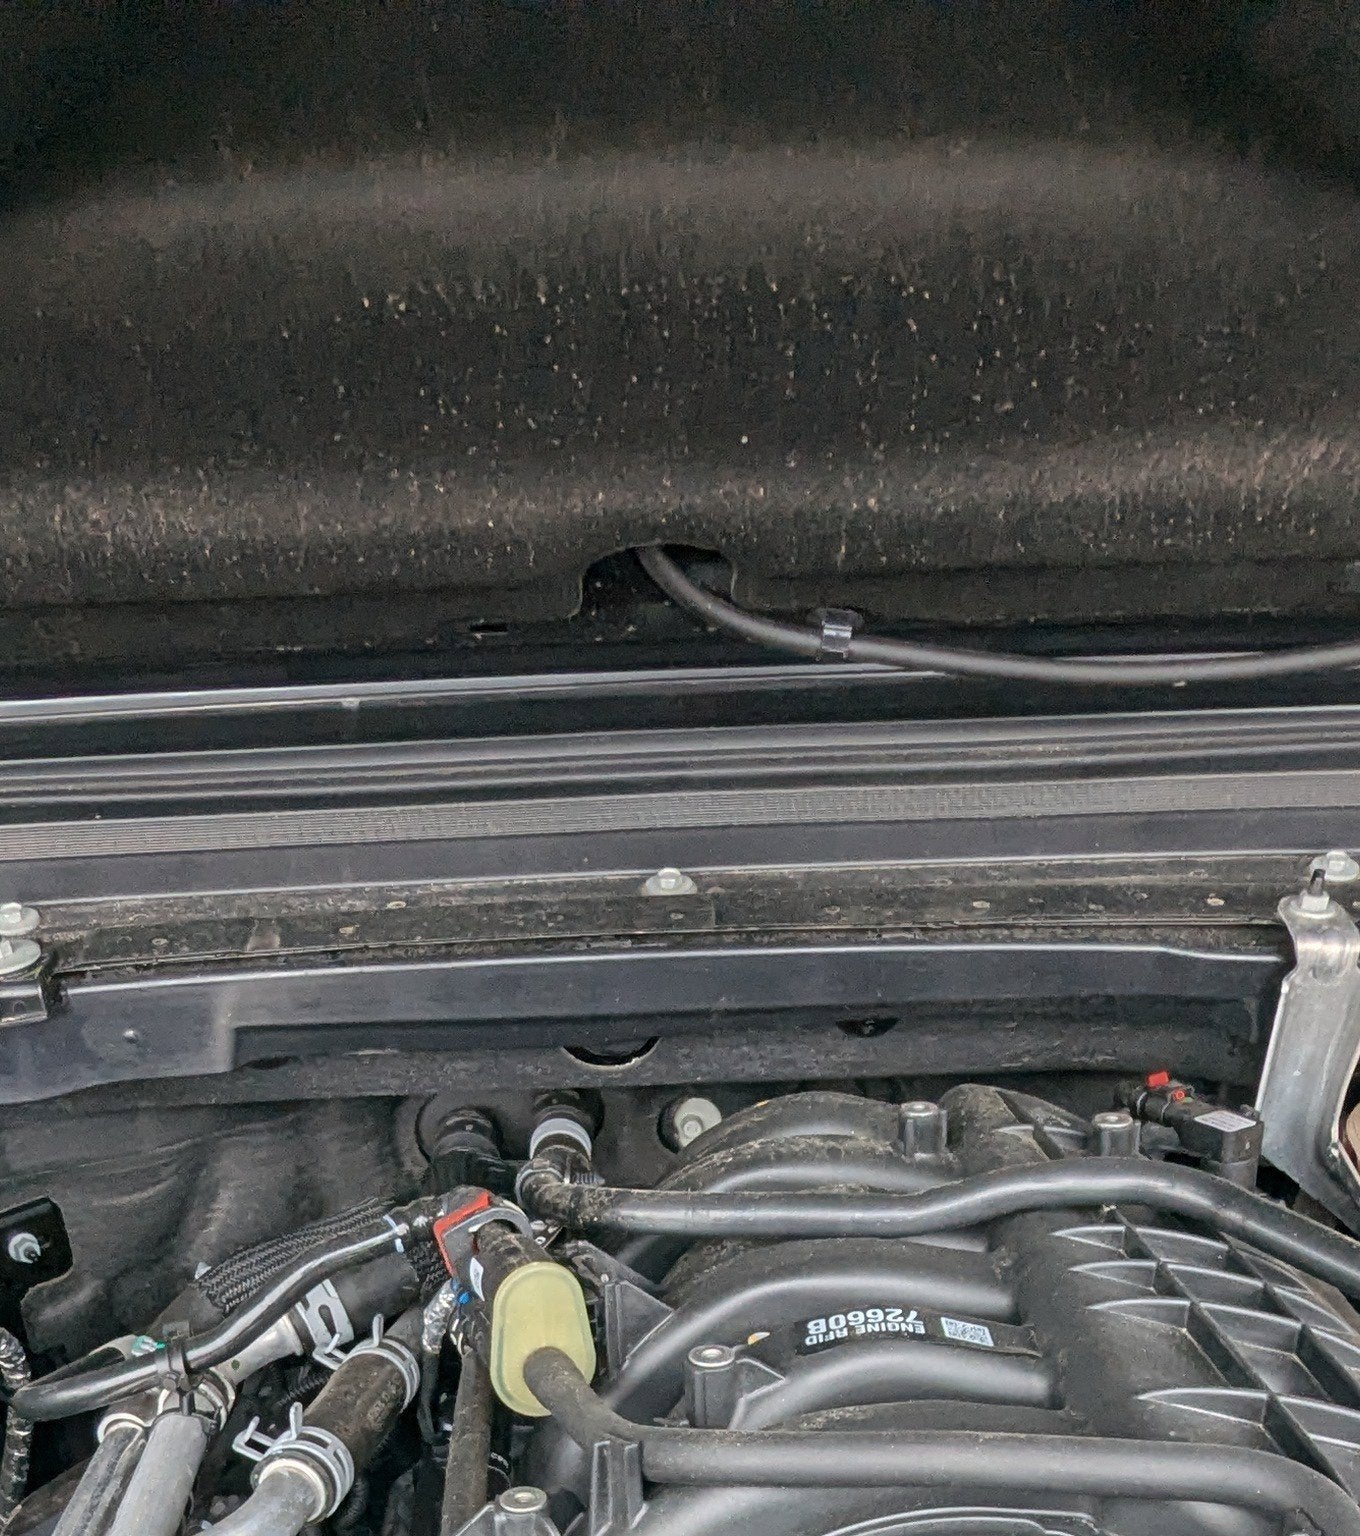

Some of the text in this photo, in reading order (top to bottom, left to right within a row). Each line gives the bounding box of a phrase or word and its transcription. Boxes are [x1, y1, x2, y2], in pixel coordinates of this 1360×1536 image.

[804, 1321, 925, 1346] ENGINE RFID
[807, 1308, 919, 1335] 72660B
